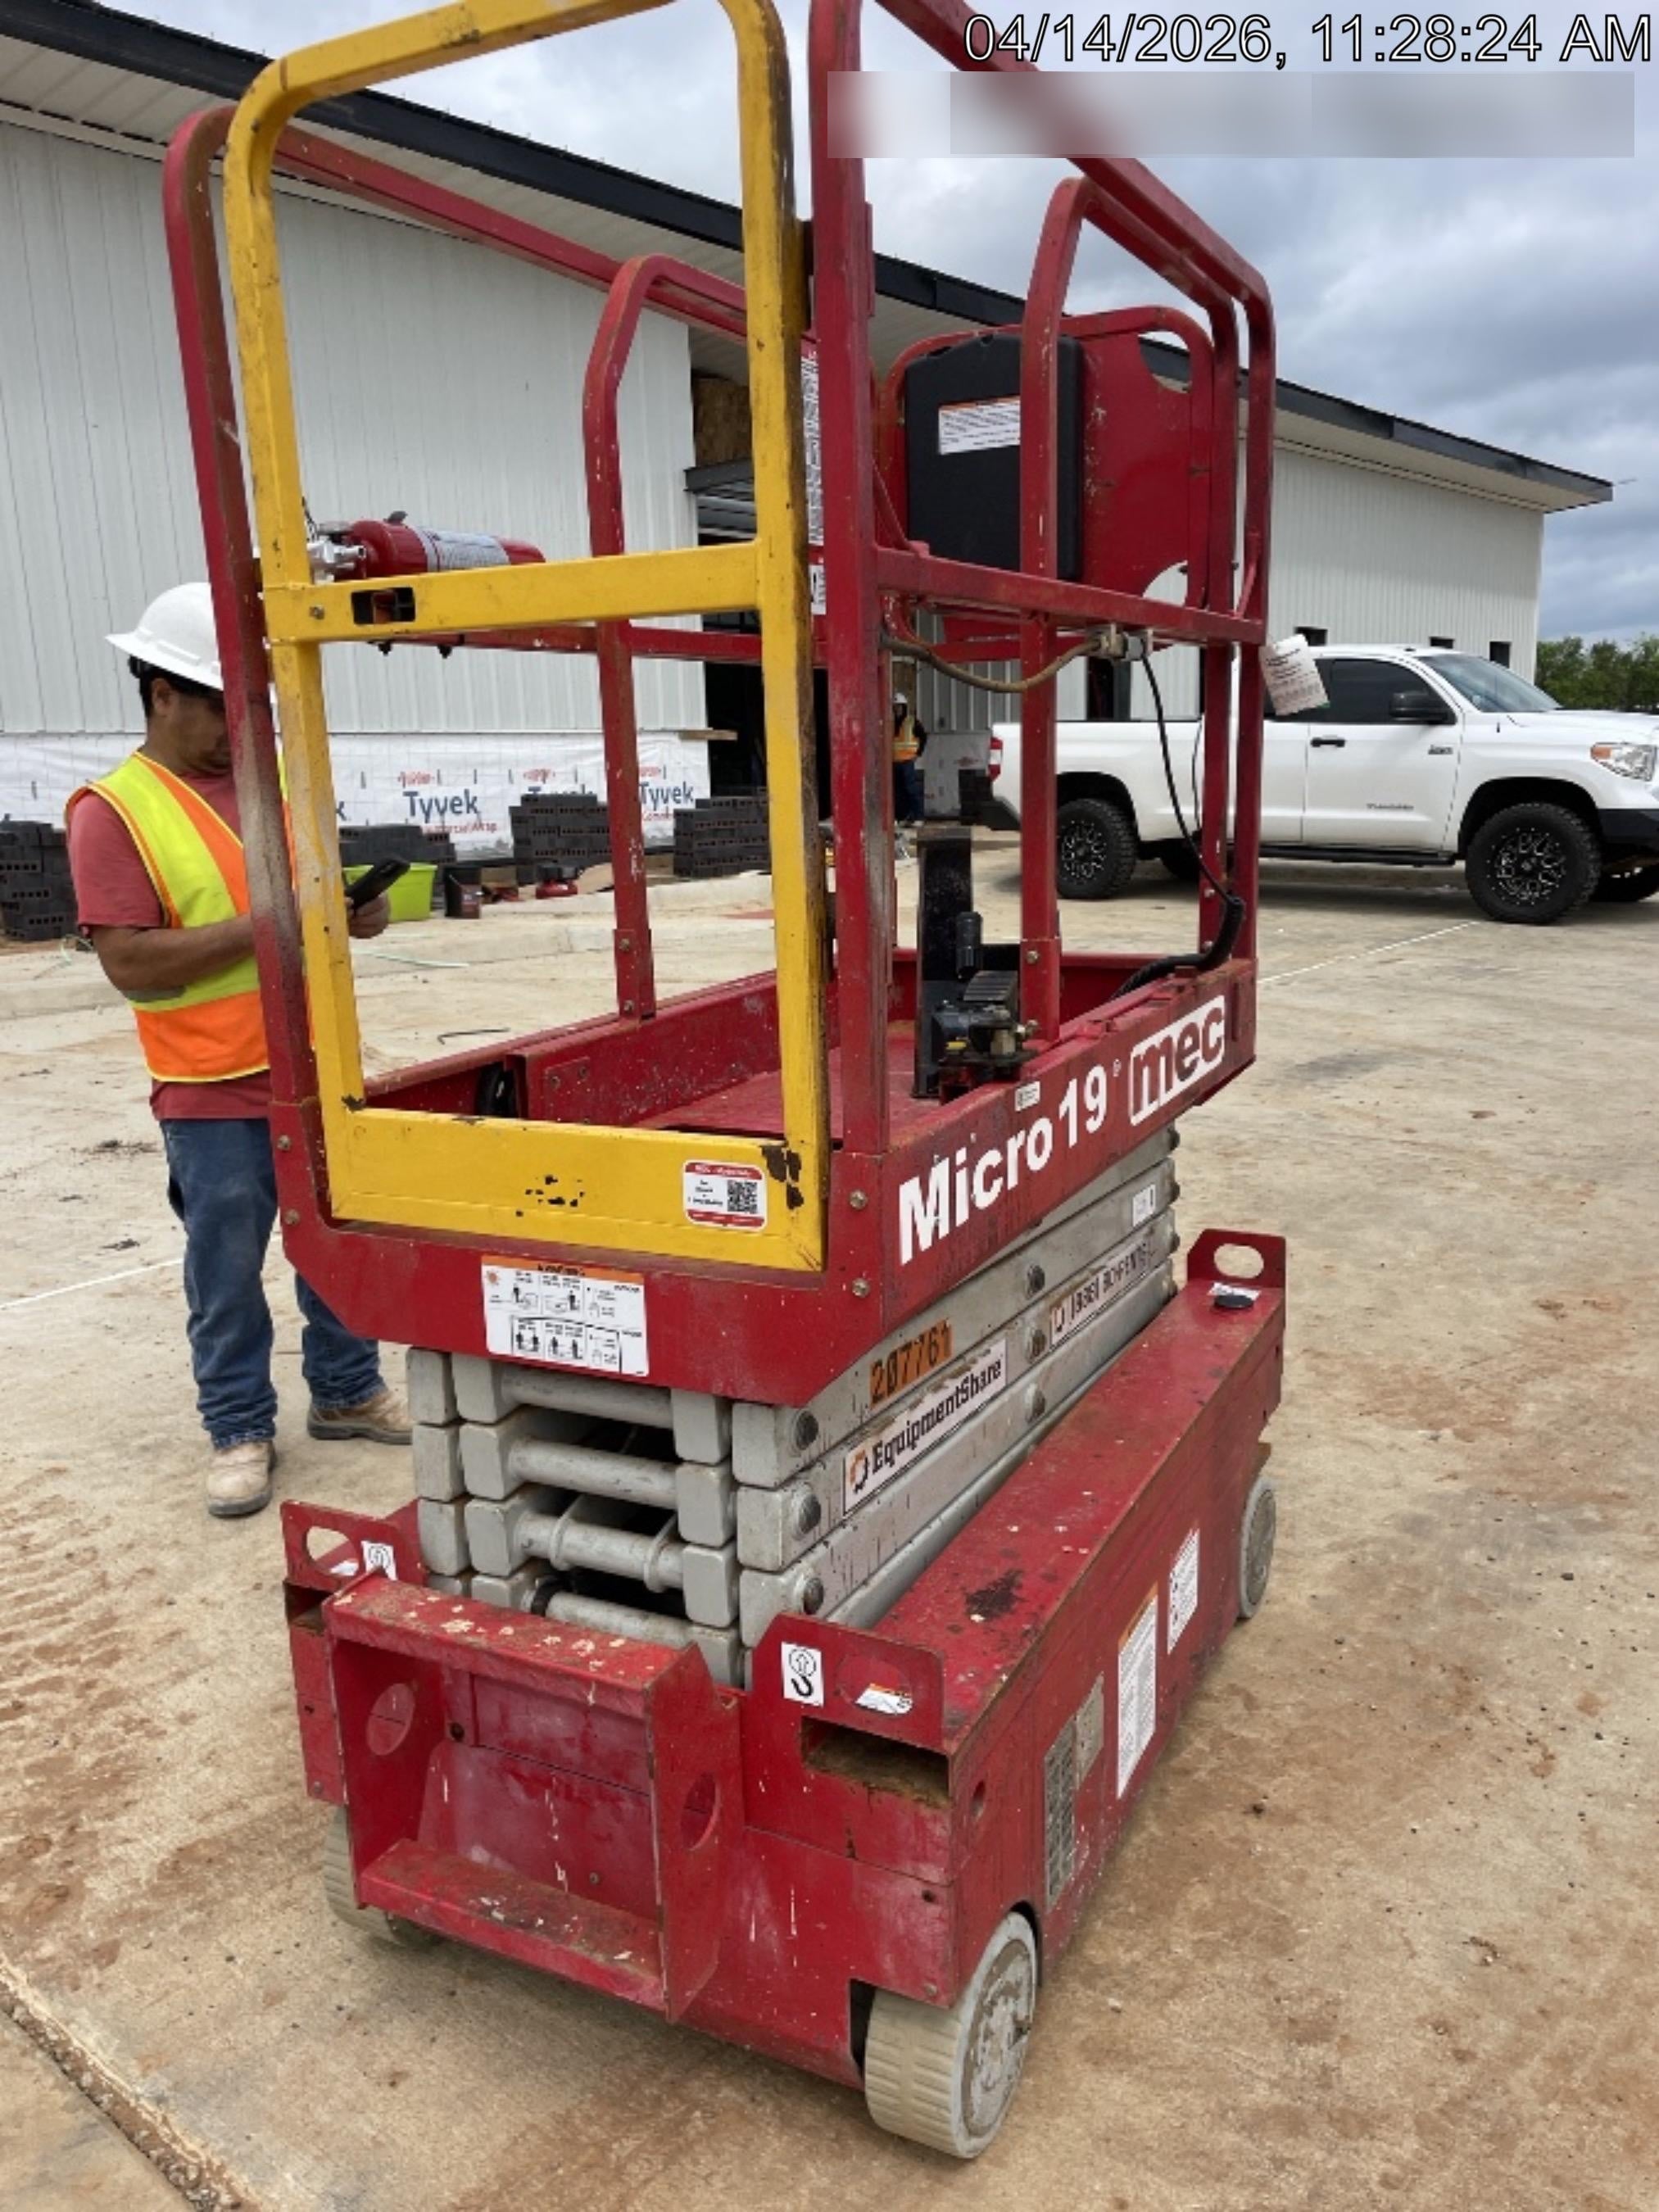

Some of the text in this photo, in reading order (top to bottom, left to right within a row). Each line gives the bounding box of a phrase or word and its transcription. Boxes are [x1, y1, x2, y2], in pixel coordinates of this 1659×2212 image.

[402, 788, 479, 824] Tyvek
[639, 781, 694, 811] Tyvek
[1131, 1004, 1226, 1121] mec
[900, 1064, 1108, 1267] Micro 19
[873, 1358, 1002, 1475] EquipmentShare
